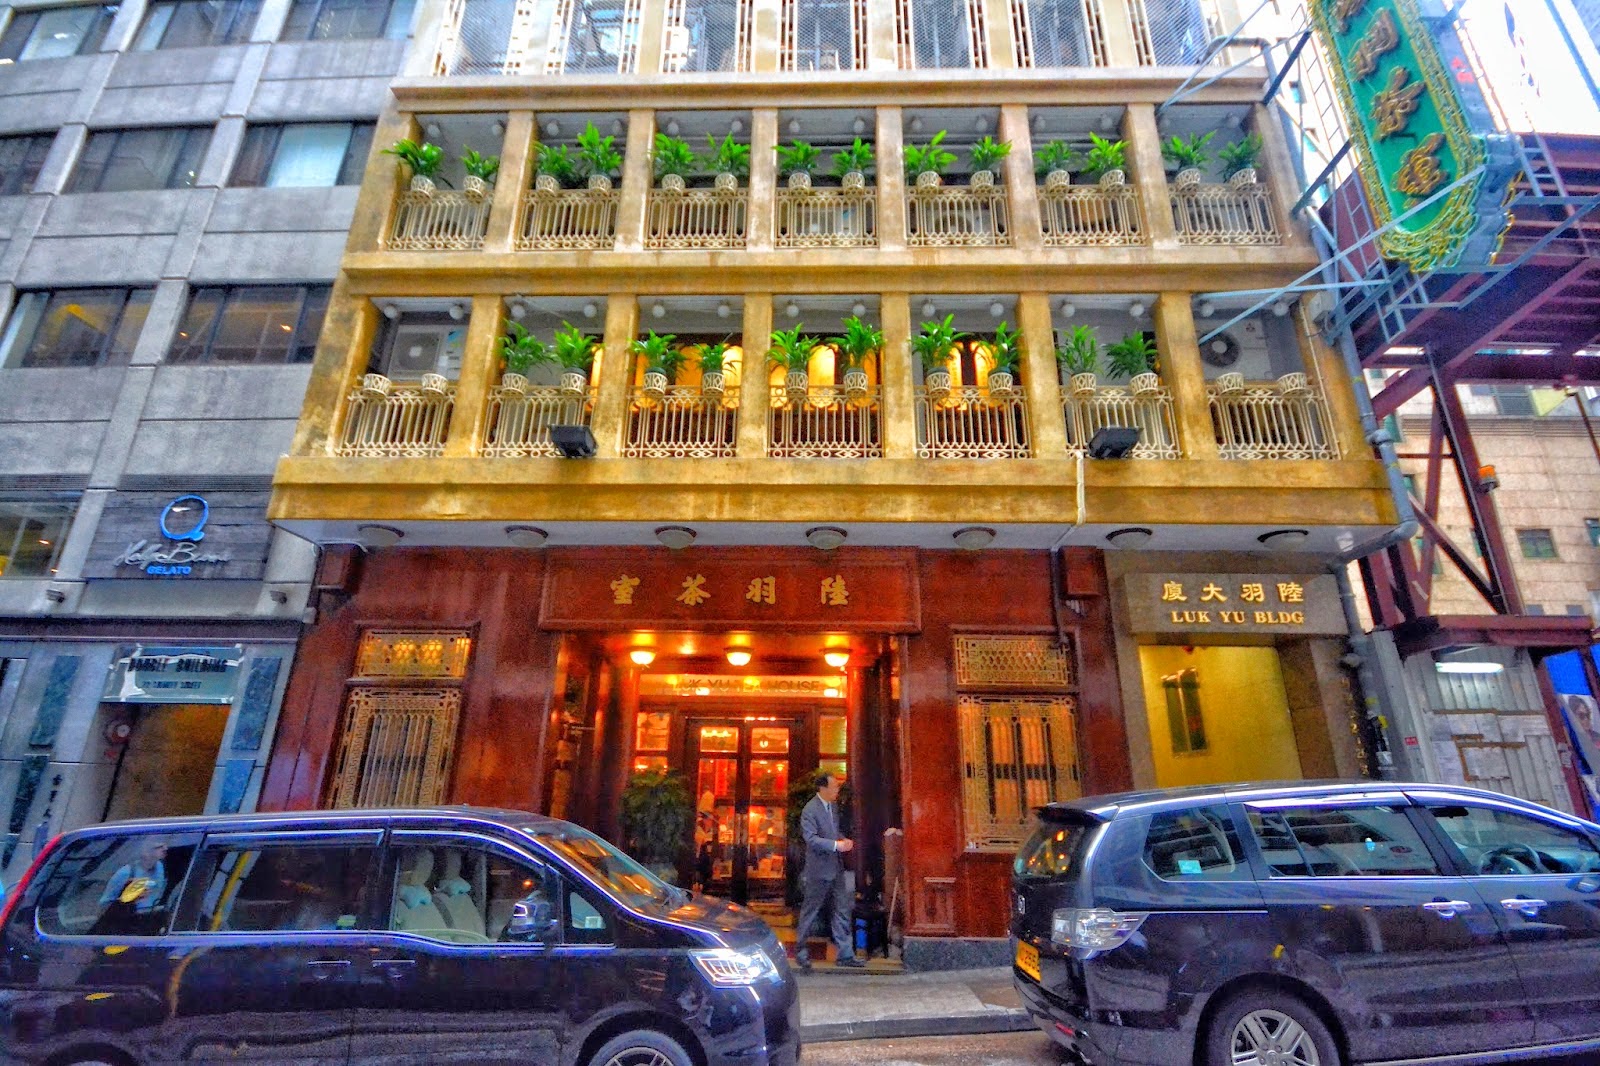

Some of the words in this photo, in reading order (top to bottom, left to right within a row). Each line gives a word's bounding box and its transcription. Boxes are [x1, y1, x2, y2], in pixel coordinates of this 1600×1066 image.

[146, 565, 192, 575] GELATO
[1171, 611, 1211, 623] LUK
[1219, 611, 1246, 623] YU
[1255, 611, 1305, 624] BLDG
[768, 680, 821, 693] HOUSE
